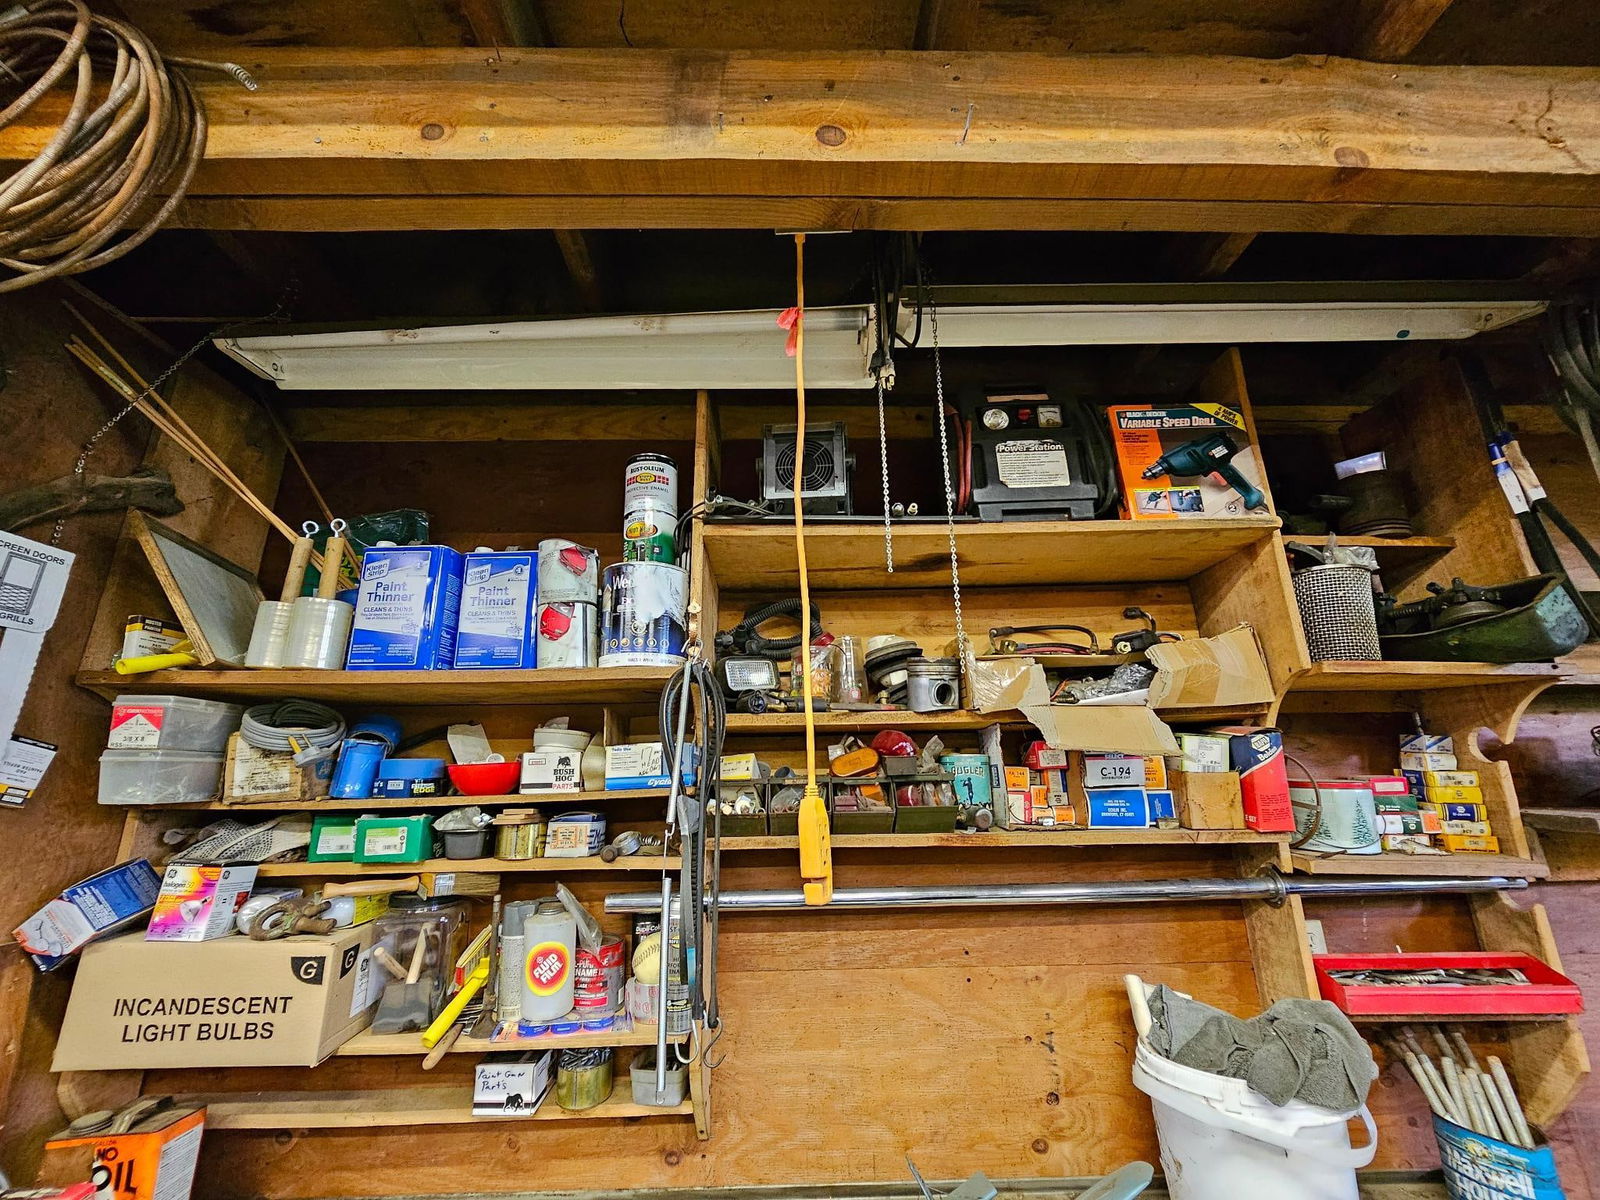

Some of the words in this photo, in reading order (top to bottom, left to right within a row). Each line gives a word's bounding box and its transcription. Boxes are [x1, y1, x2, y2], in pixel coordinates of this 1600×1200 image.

[1220, 413, 1239, 425] POWER
[1222, 407, 1237, 419] AMPS
[1120, 418, 1162, 428] VARIABLE
[1162, 417, 1191, 428] SPEED
[1191, 416, 1216, 426] DRILL
[999, 445, 1027, 453] Power
[630, 465, 665, 474] RUST-OLEUM
[650, 485, 669, 493] ENAMEL
[32, 550, 65, 565] DOORS
[366, 563, 388, 572] Klean
[367, 569, 385, 578] Strip
[375, 581, 408, 592] Paint
[478, 586, 509, 596] Paint
[366, 592, 415, 602] Thinner
[469, 596, 517, 607] Thinner
[0, 612, 34, 626] GRILLS
[1256, 745, 1278, 761] Belden
[553, 768, 575, 776] BUSH
[1100, 767, 1131, 777] C-194
[413, 786, 436, 794] EDGE
[163, 880, 187, 889] halogen
[344, 951, 356, 969] G
[533, 953, 559, 979] FLUID
[299, 961, 318, 979] G
[540, 960, 564, 985] FILM
[575, 967, 605, 977] NAMEL
[113, 996, 293, 1018] INCANDESCENT
[121, 1023, 191, 1043] LIGHT
[196, 1022, 275, 1041] BULBS
[477, 1067, 501, 1080] Paint
[91, 1159, 138, 1194] OIL
[1446, 1144, 1537, 1199] Maxwell
